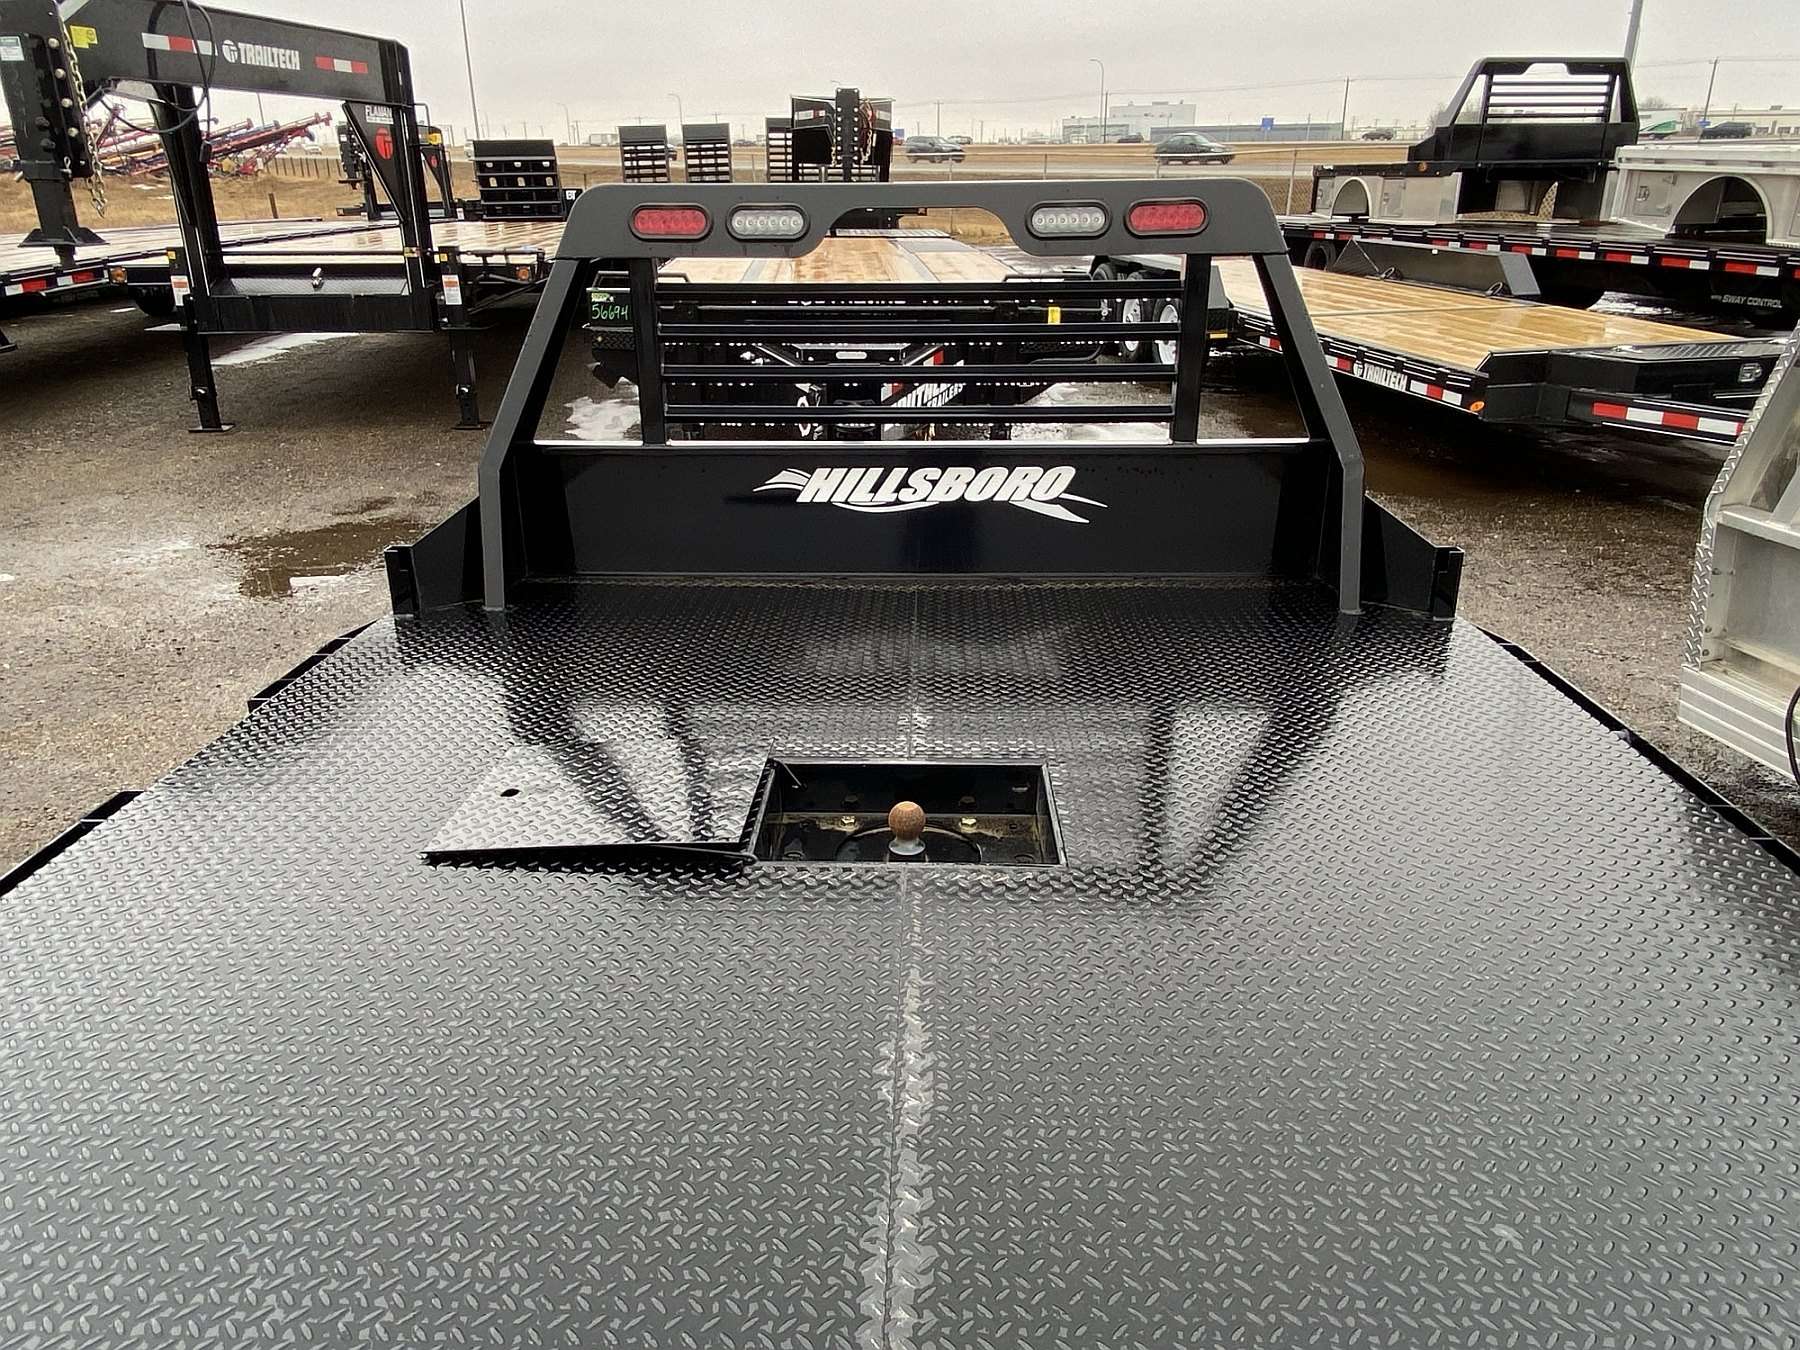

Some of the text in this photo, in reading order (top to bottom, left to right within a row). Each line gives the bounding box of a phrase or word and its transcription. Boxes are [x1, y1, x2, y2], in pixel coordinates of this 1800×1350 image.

[238, 42, 301, 71] TRAILTECH
[591, 303, 629, 321] 56694
[1747, 297, 1783, 309] CONTROL
[1363, 363, 1408, 392] TRAILTECH
[796, 465, 1077, 503] HILLSBORO
